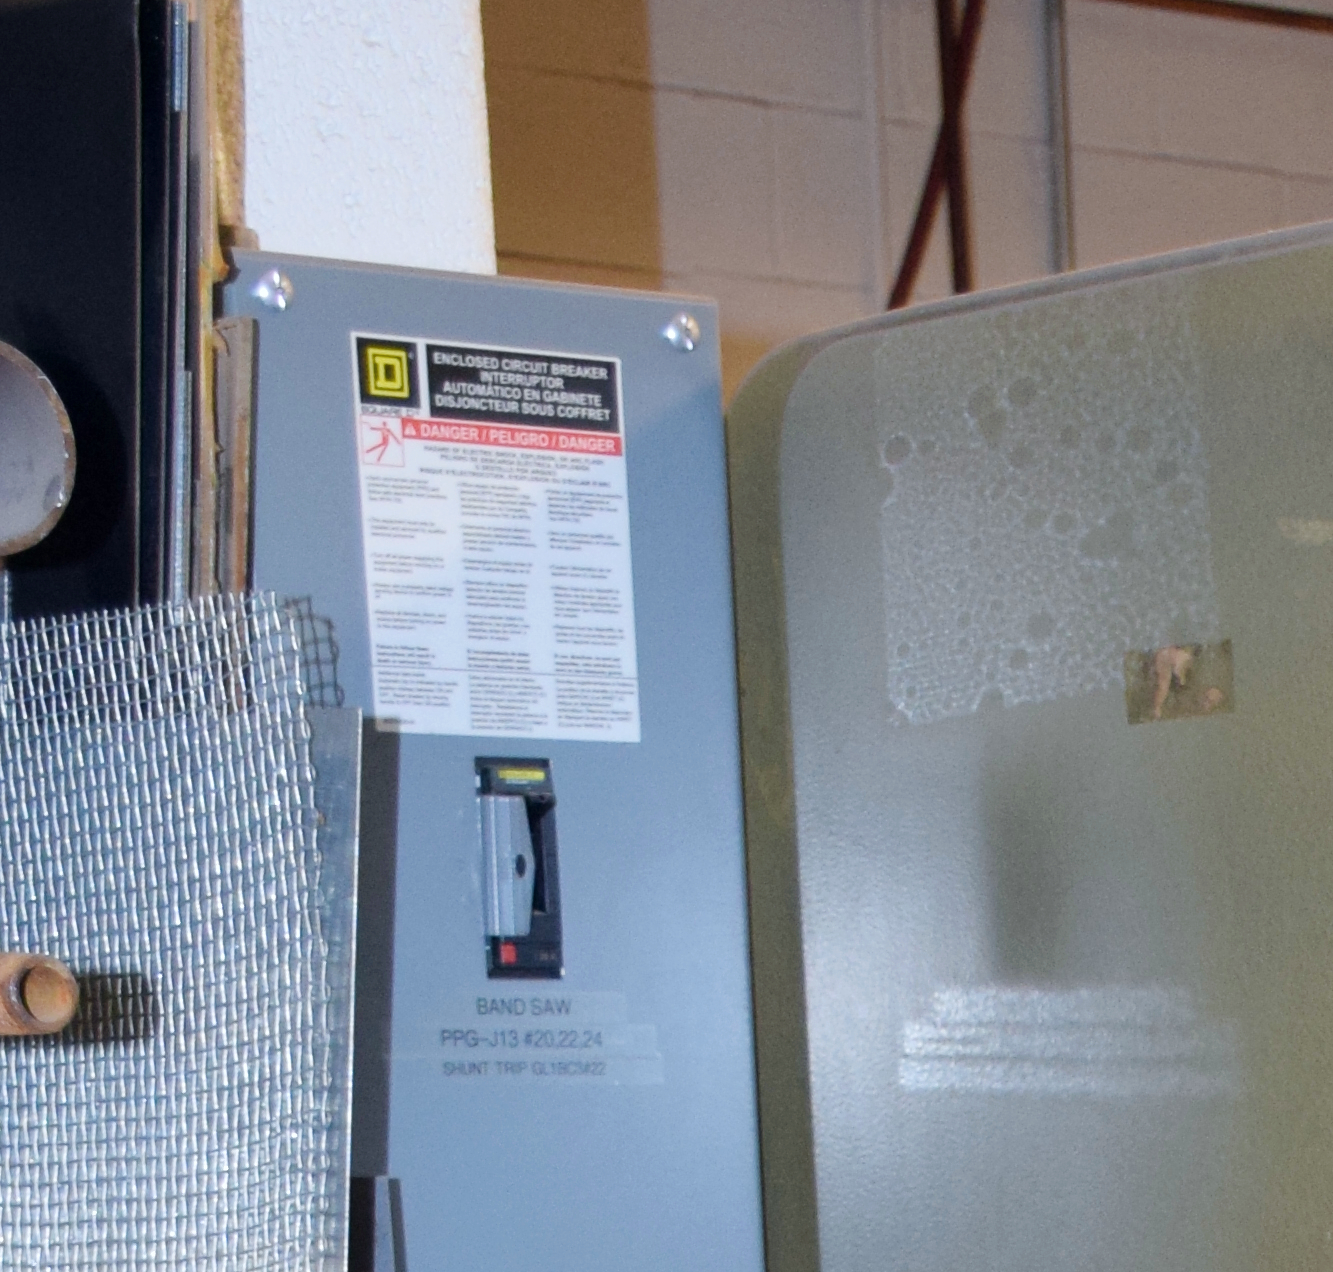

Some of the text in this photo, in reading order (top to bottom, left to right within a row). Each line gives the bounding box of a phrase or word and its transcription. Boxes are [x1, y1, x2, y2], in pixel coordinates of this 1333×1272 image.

[433, 351, 608, 379] ENCLOSED CIRCUIT BREAKER
[480, 370, 565, 389] INTERRUPTOR
[434, 394, 611, 421] DISJONCTEUR SOUS COFFRET
[523, 388, 541, 401] EN
[542, 390, 602, 407] GABINETE
[420, 424, 479, 441] DANGER
[490, 429, 549, 447] PELIGRO
[558, 435, 616, 452] DANGER
[475, 997, 571, 1016] BAND SAW
